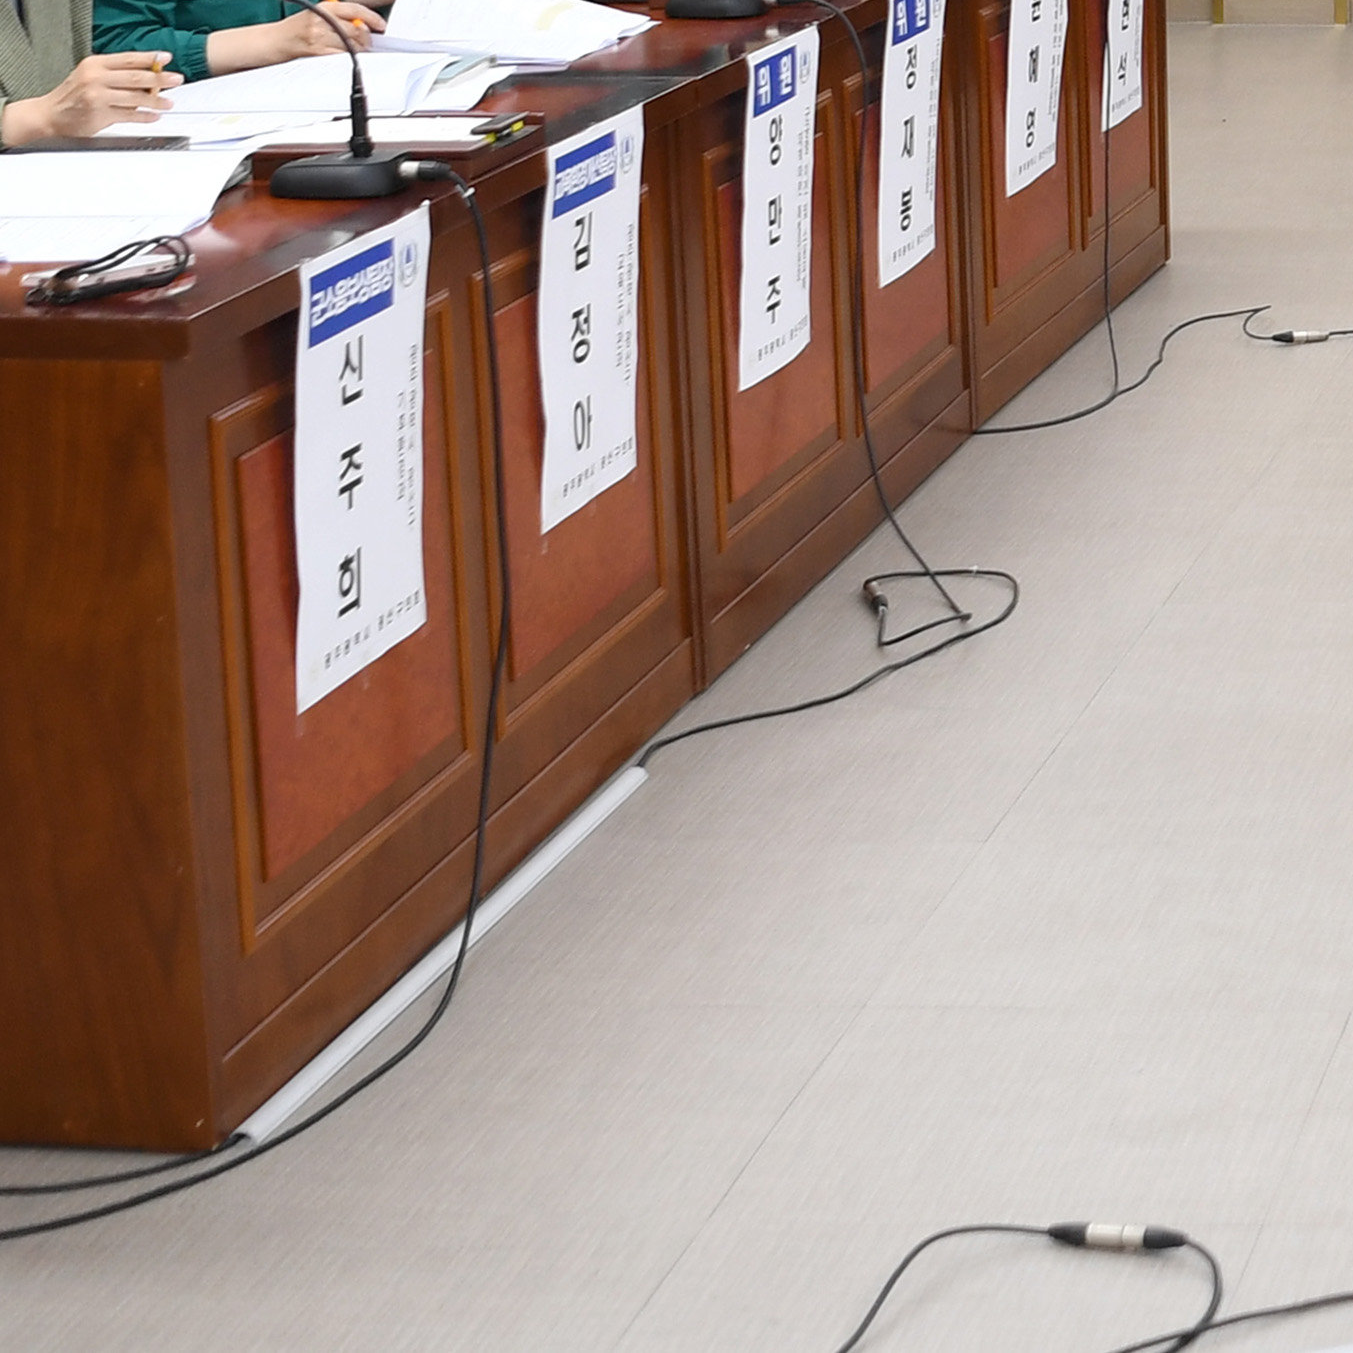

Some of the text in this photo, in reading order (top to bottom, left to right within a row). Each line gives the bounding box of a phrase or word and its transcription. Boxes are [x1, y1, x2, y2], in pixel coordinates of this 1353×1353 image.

[766, 115, 782, 323] 양만주
[900, 45, 916, 231] 정재봉
[309, 255, 396, 328] 군소음보상팀장
[571, 212, 592, 451] 김정아
[338, 336, 363, 618] 신주희
